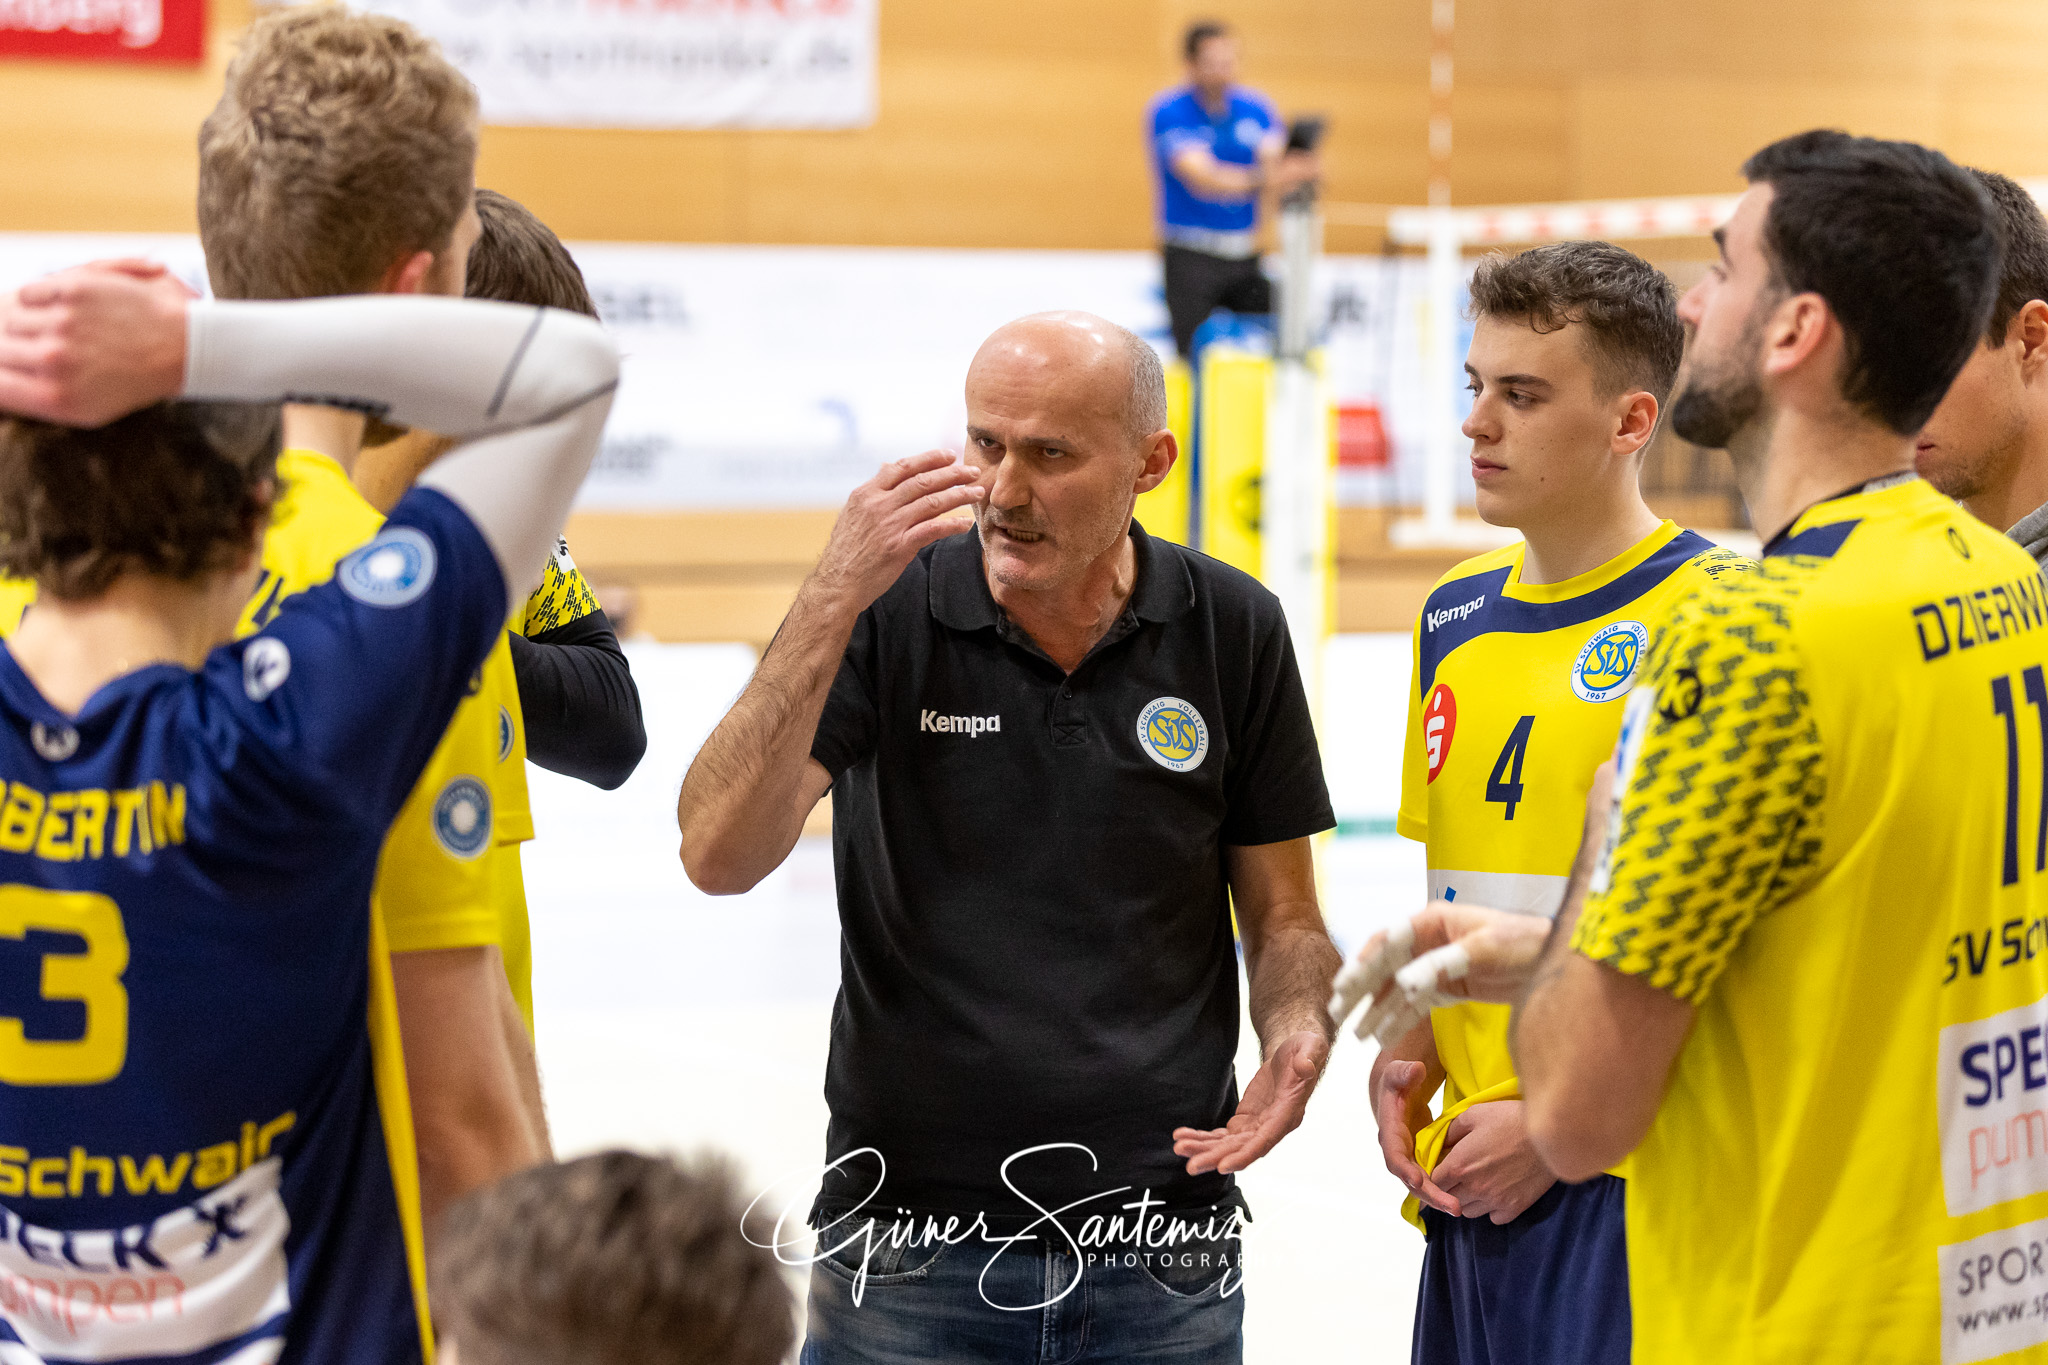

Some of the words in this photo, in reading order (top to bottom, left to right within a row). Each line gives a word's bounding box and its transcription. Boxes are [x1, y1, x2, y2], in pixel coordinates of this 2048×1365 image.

[1427, 594, 1486, 633] Kempa
[1580, 625, 1619, 660] SCHWAIG
[1912, 572, 2048, 662] DZIERW
[920, 708, 1001, 738] Kempa
[1585, 691, 1607, 700] 1967
[1140, 701, 1166, 731] SCHWAIG
[1178, 702, 1206, 752] VOLLEYBALL
[1167, 761, 1184, 769] 1967
[1485, 715, 1536, 821] 4
[0, 777, 187, 863] BERTIN
[0, 883, 130, 1087] 3
[1961, 1022, 2048, 1108] SPE
[1968, 1108, 2048, 1192] pum
[1958, 1236, 2048, 1296] SPOR
